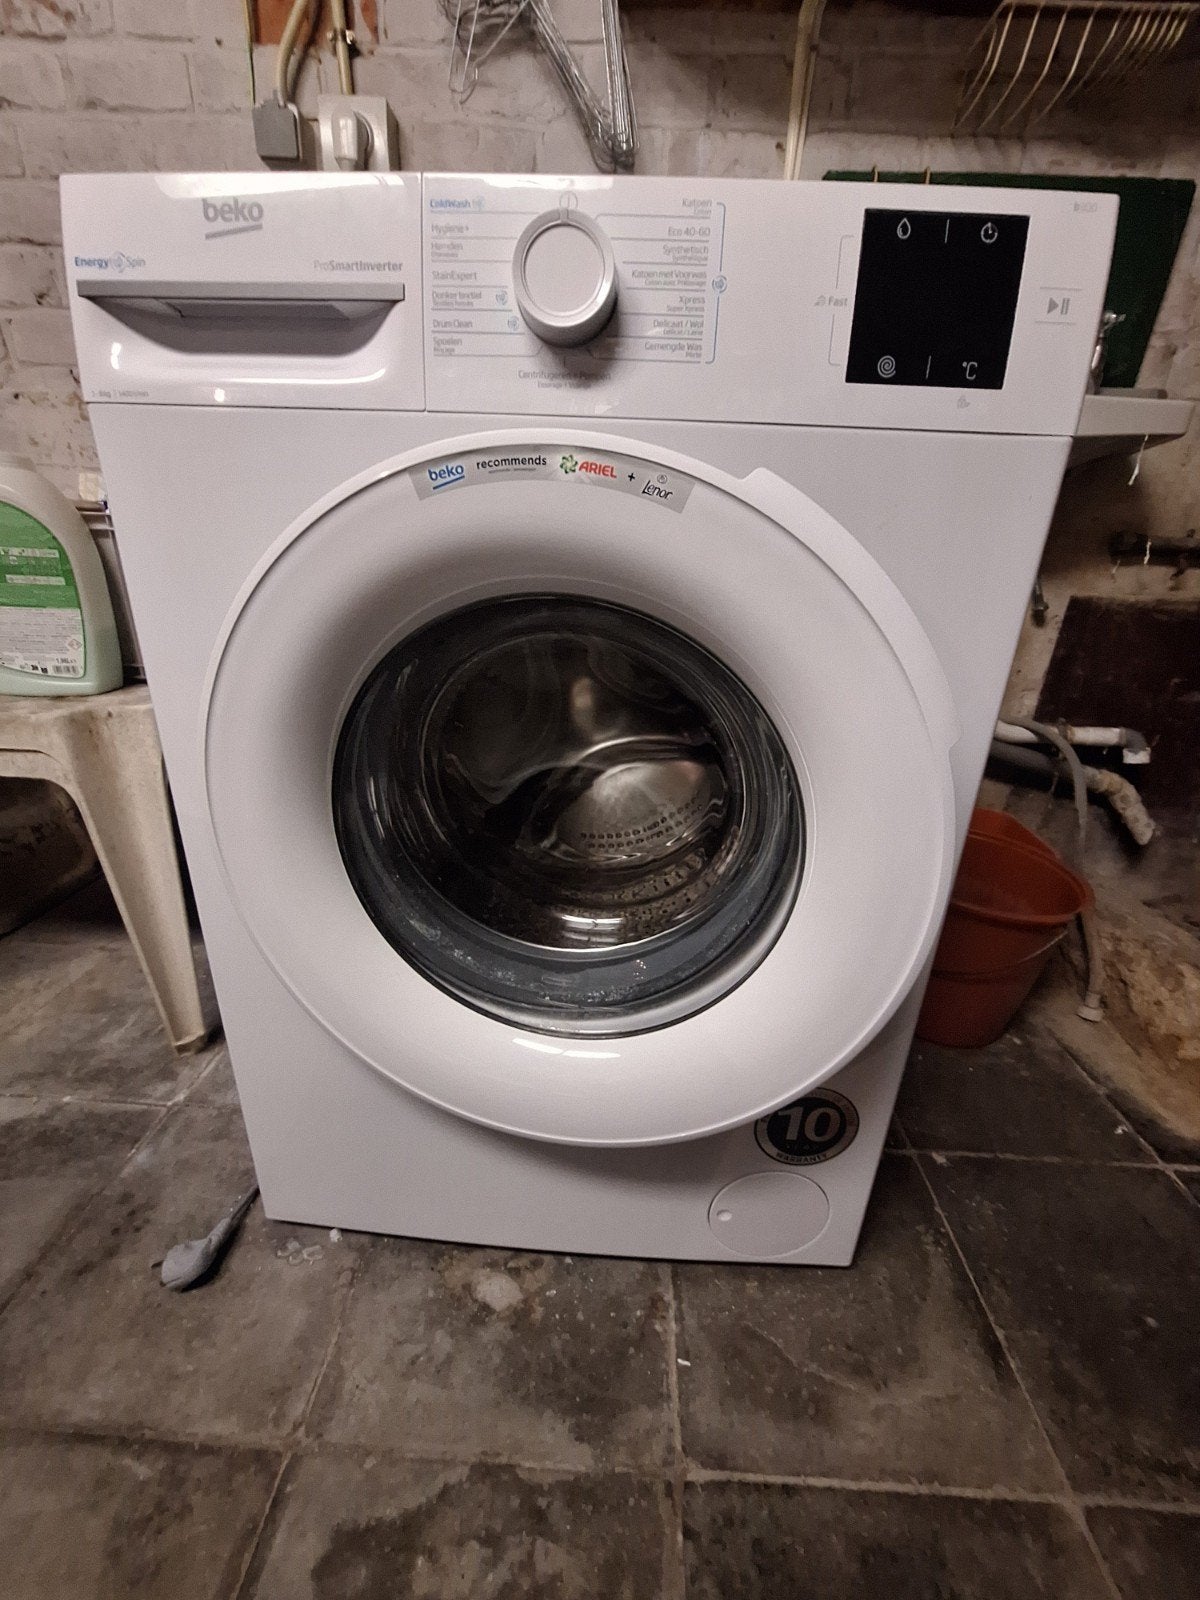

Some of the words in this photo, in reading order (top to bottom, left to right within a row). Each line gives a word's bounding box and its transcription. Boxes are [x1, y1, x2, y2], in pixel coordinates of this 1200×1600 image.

[682, 198, 712, 208] Katoen
[202, 197, 264, 228] beko
[668, 227, 682, 237] Eco
[684, 227, 711, 237] 40-60
[74, 256, 109, 270] Energy
[313, 260, 403, 272] ProSmartInverter
[432, 271, 478, 282] StainExpert
[679, 295, 706, 306] Xpress
[828, 295, 849, 307] Fast
[427, 463, 465, 484] beko
[476, 454, 547, 470] recommends
[578, 460, 617, 479] ARIEL
[627, 472, 636, 482] +
[641, 480, 673, 500] Lenor
[778, 1106, 841, 1142] 10
